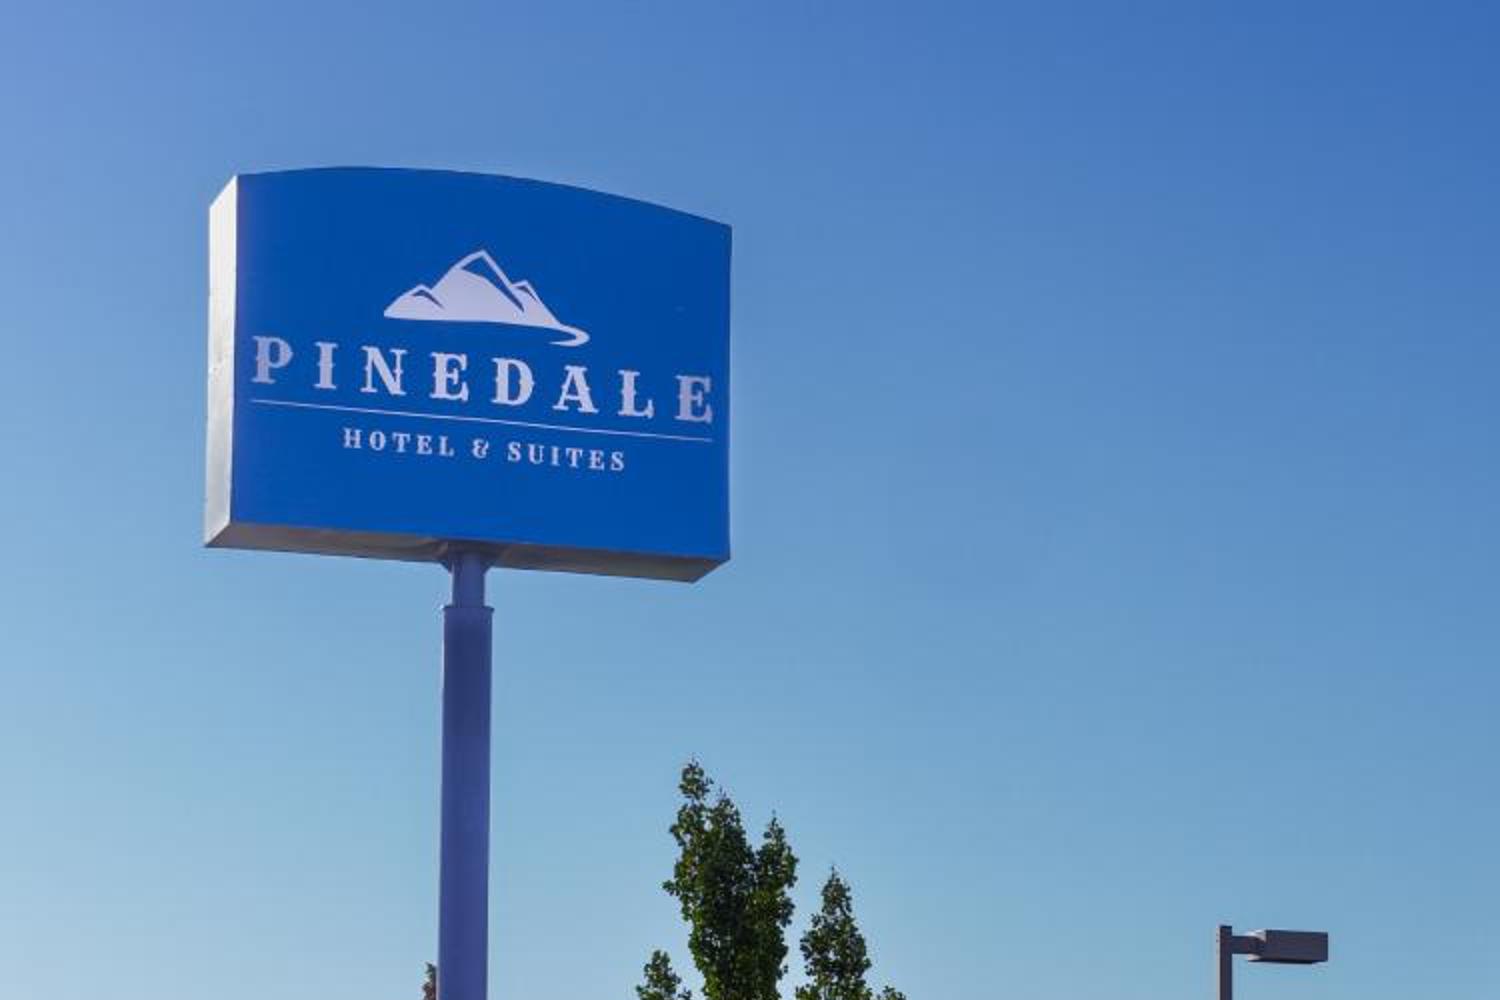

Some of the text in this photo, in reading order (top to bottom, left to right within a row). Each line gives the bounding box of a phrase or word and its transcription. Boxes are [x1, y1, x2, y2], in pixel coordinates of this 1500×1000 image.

[252, 335, 714, 424] PINEDALE
[343, 427, 626, 472] HOTEL & SUITES
